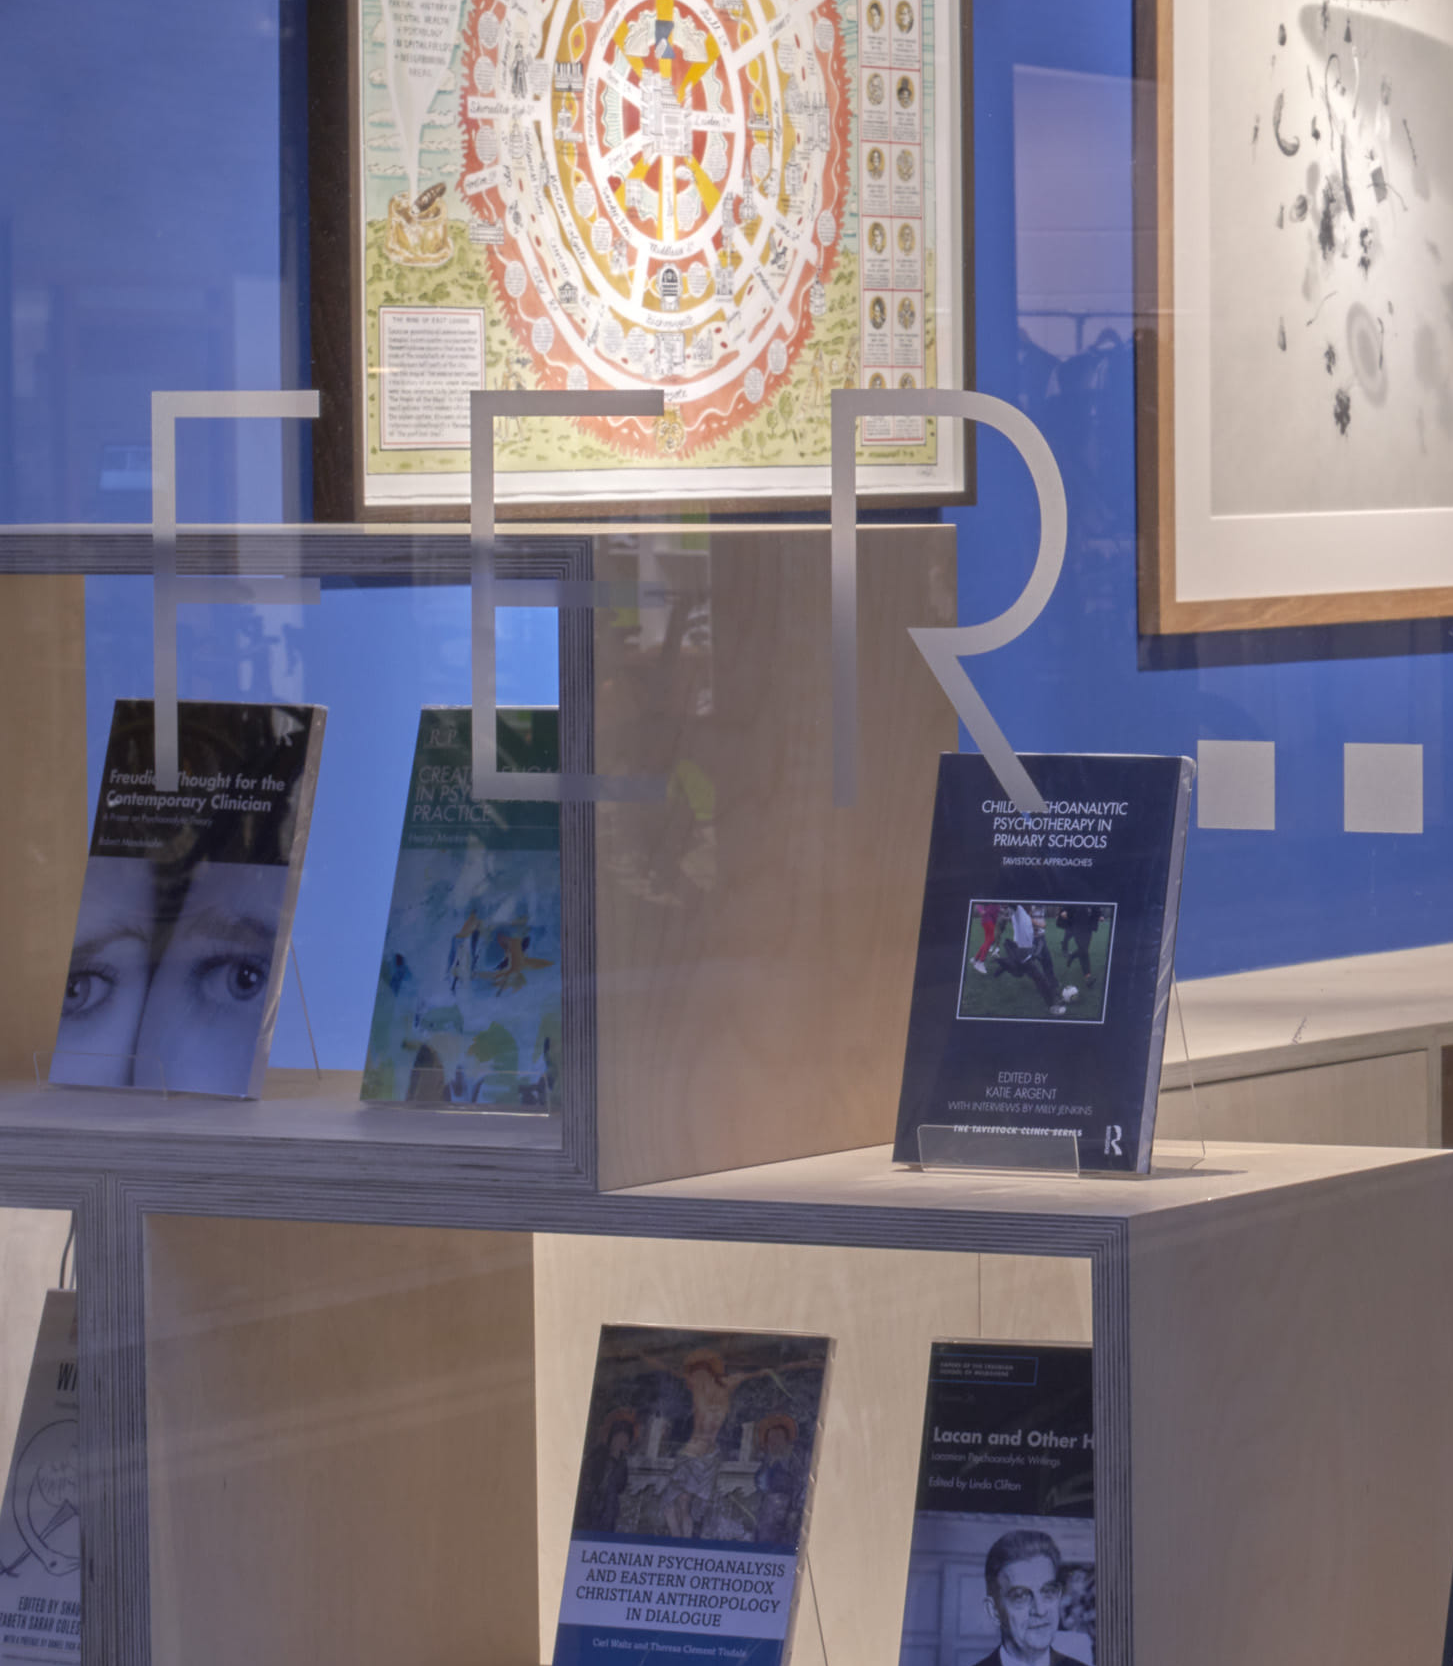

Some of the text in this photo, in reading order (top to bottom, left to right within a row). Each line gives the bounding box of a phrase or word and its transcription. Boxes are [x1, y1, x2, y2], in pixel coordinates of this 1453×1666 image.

[235, 773, 257, 790] for
[262, 775, 285, 791] the
[106, 790, 272, 813] Contemporary Clinician
[412, 804, 493, 822] PRACTICE
[993, 818, 1112, 831] PSYCHOTHERAPY IN
[993, 834, 1107, 848] PRIMARY SCHOOLS
[998, 1072, 1048, 1084] EDITED BY
[985, 1087, 1056, 1099] KATIE ARGENT
[934, 1426, 981, 1444] Lacan
[988, 1429, 1021, 1446] and
[1027, 1431, 1077, 1448] Other
[929, 1477, 967, 1491] Edited by
[582, 1550, 785, 1578] LACANIAN PSYCHOANALYSIS
[586, 1569, 775, 1595] AND EASTERN ORTHODOX
[18, 1596, 58, 1615] EDITED BY
[576, 1586, 780, 1614] CHRISTIAN ANTHROPOLOGY
[28, 1615, 53, 1632] SARAH
[626, 1608, 721, 1627] IN DIALOGUE
